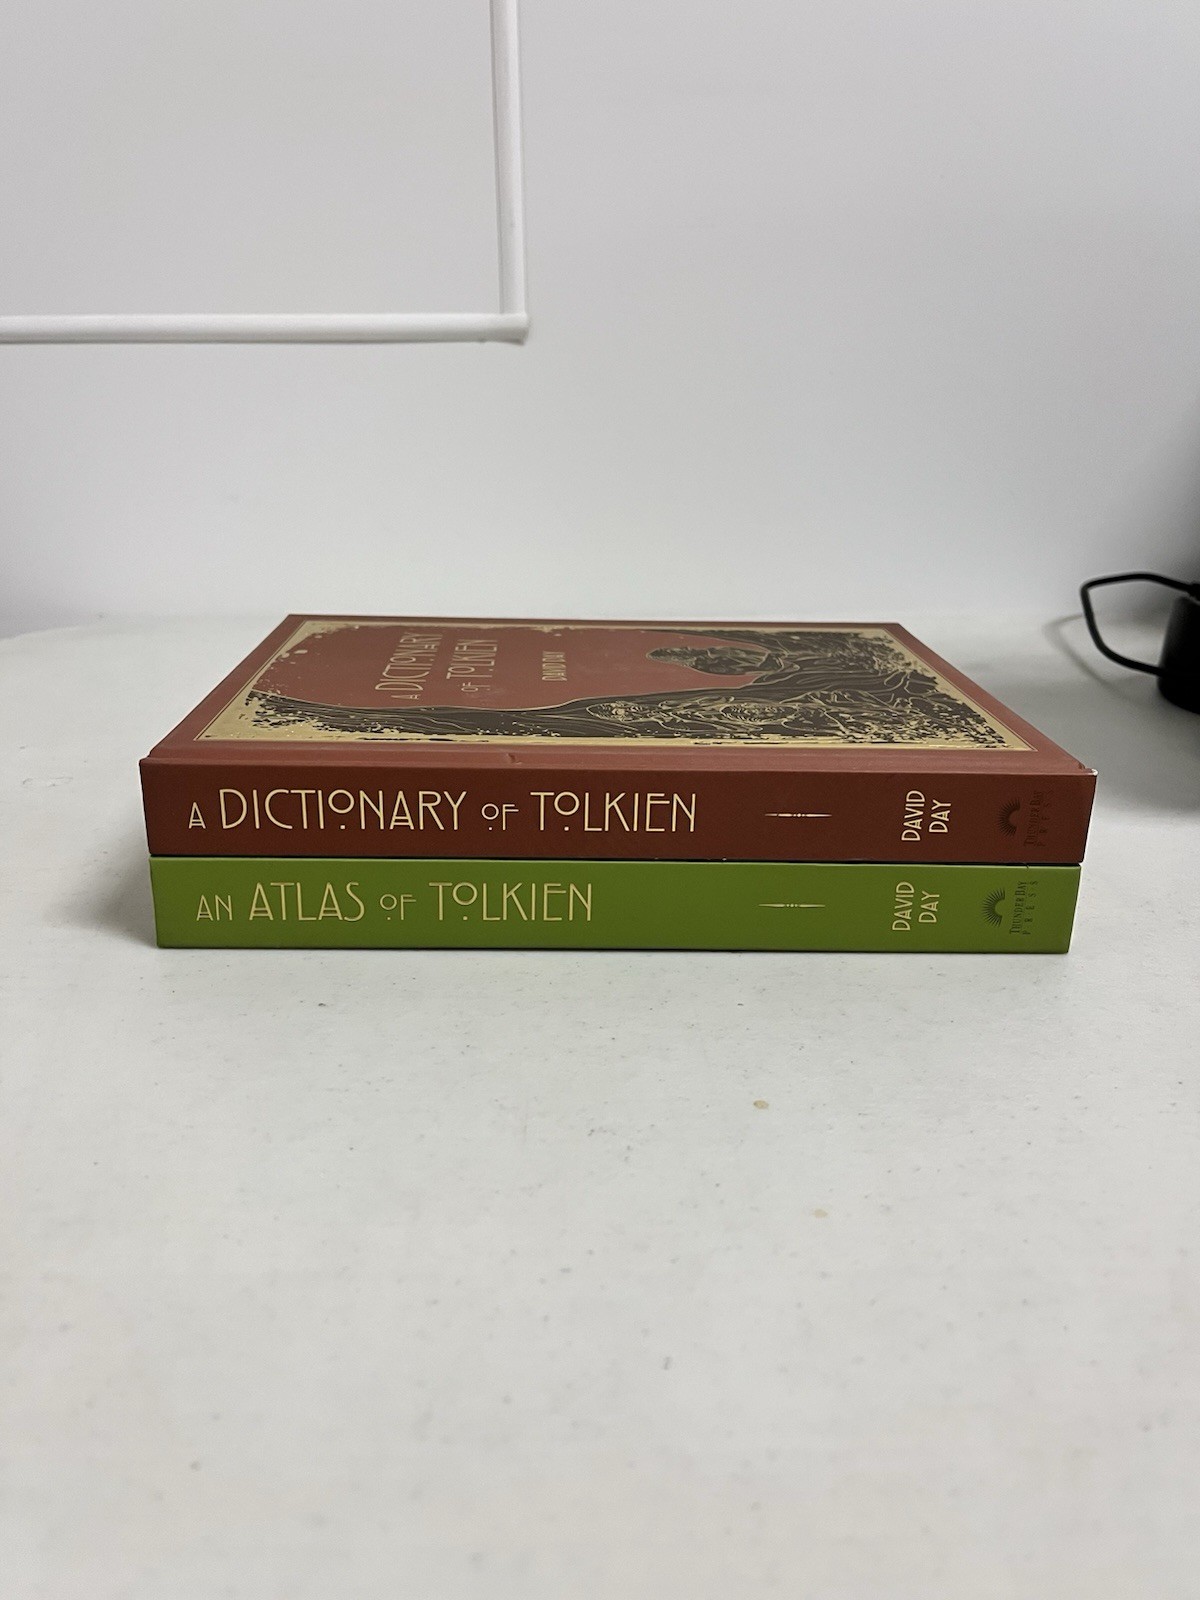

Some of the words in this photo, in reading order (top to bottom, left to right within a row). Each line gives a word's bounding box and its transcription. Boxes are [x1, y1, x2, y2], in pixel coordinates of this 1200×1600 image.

[375, 632, 443, 691] DICTIONARY
[446, 639, 498, 680] TOLKIEN
[187, 801, 206, 830] A
[218, 788, 468, 831] DICTIONARY
[480, 803, 519, 832] OF
[530, 791, 697, 833] TOLKIEN
[901, 790, 925, 841] DAVID
[929, 799, 951, 833] DAY
[196, 894, 233, 922] AN
[248, 881, 365, 923] ATLAS
[379, 893, 417, 922] OF
[428, 881, 594, 922] TOLKIEN
[892, 881, 915, 931] DAVID
[918, 890, 940, 923] DAY
